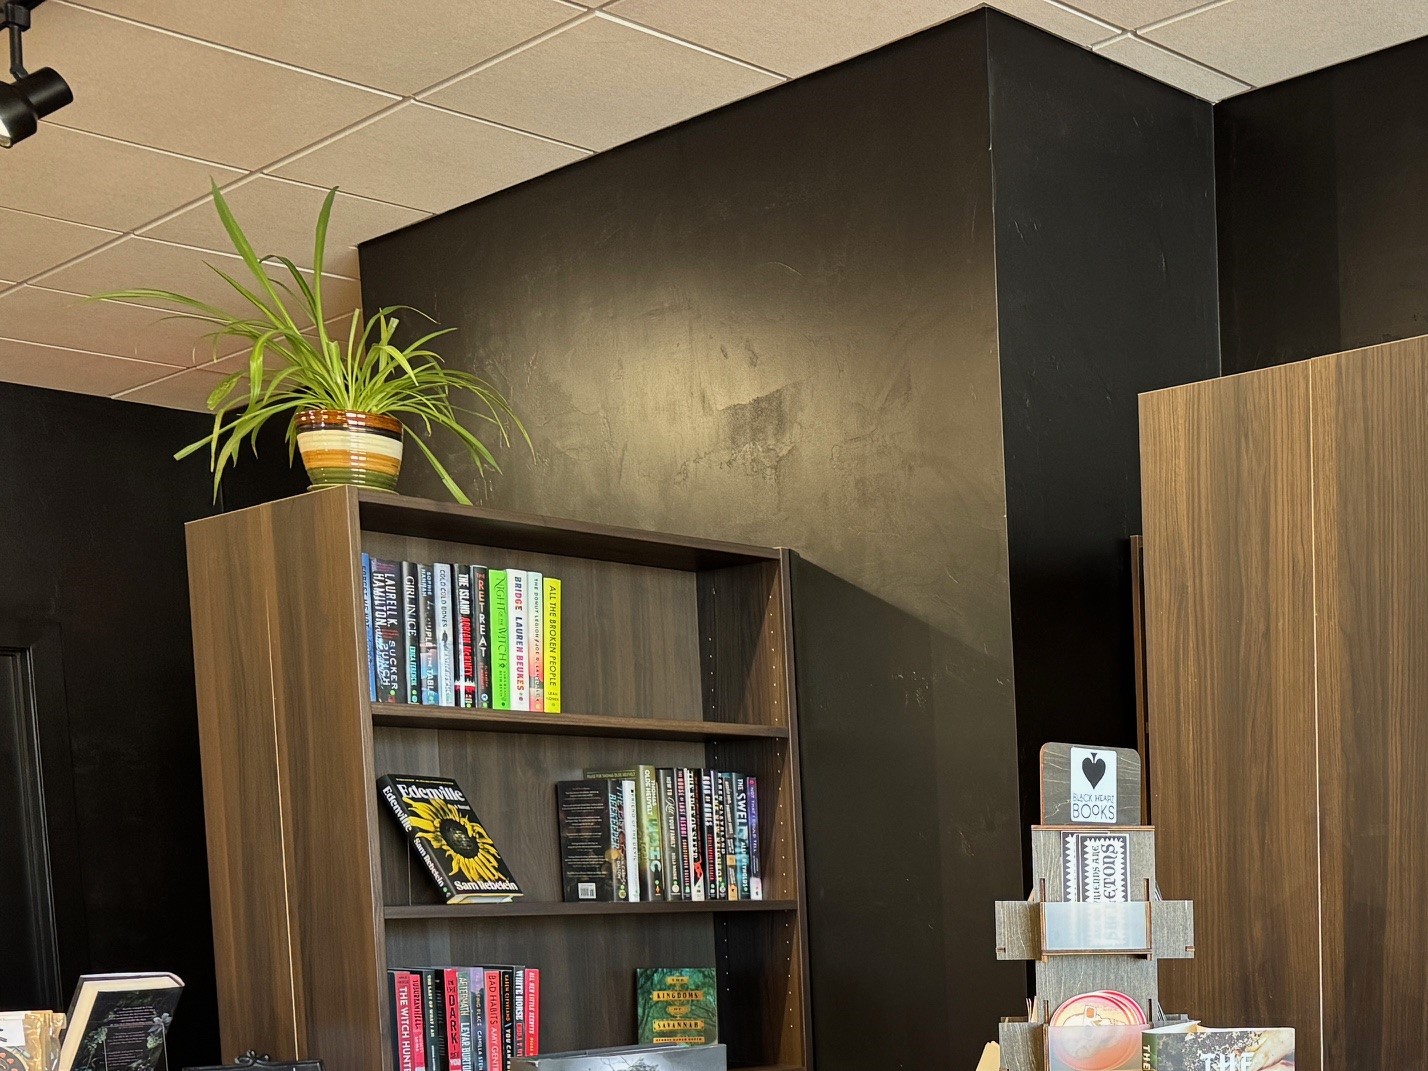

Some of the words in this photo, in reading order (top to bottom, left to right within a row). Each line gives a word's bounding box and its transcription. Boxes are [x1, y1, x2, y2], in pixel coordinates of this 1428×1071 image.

[397, 784, 465, 801] Edenville
[1073, 793, 1092, 802] BLACK
[1095, 794, 1114, 803] HEART
[1073, 804, 1114, 819] BOOKS
[454, 881, 479, 891] Sam
[479, 882, 518, 890] Rebelein
[399, 987, 407, 1005] THE
[400, 1008, 409, 1038] WITCH
